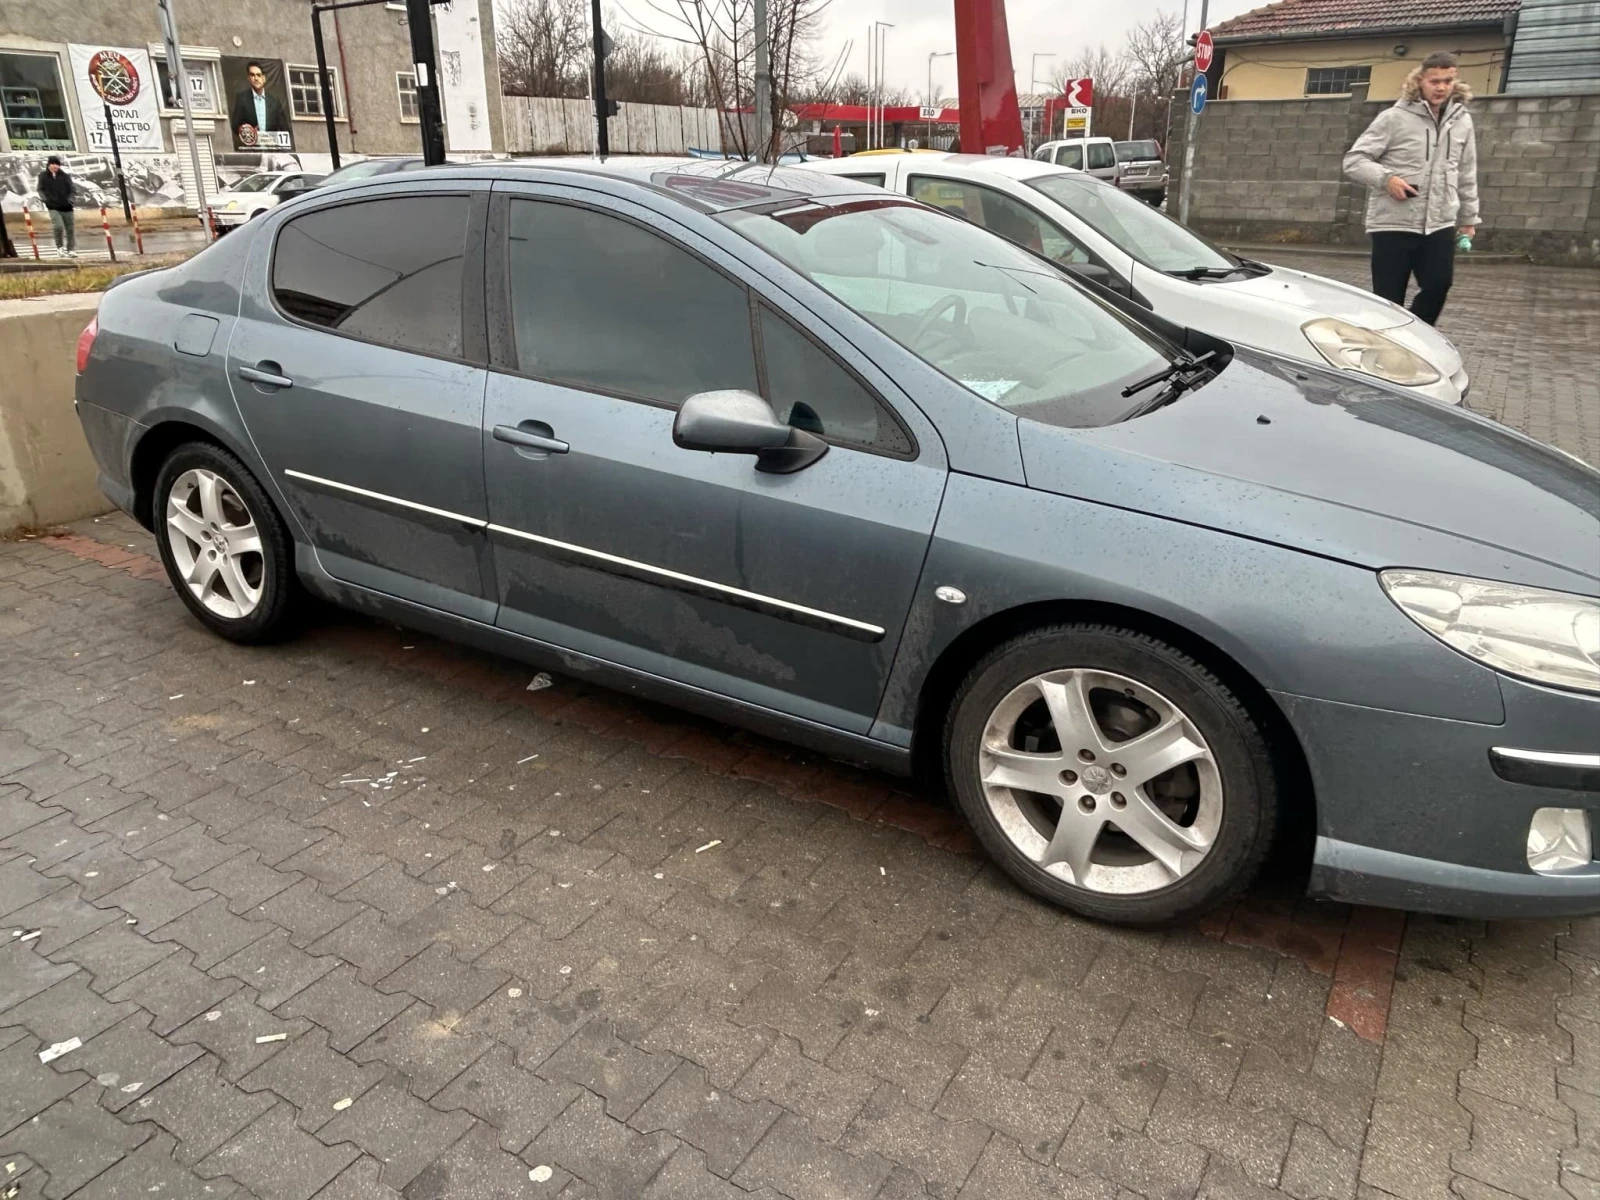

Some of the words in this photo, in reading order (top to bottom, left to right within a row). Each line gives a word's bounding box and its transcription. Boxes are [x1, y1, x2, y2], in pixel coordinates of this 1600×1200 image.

[99, 51, 121, 61] МЕЧ
[1197, 42, 1212, 59] STOP
[190, 78, 203, 90] 17
[108, 109, 139, 119] ОРАЛ
[89, 131, 103, 144] 17
[278, 133, 289, 145] 17
